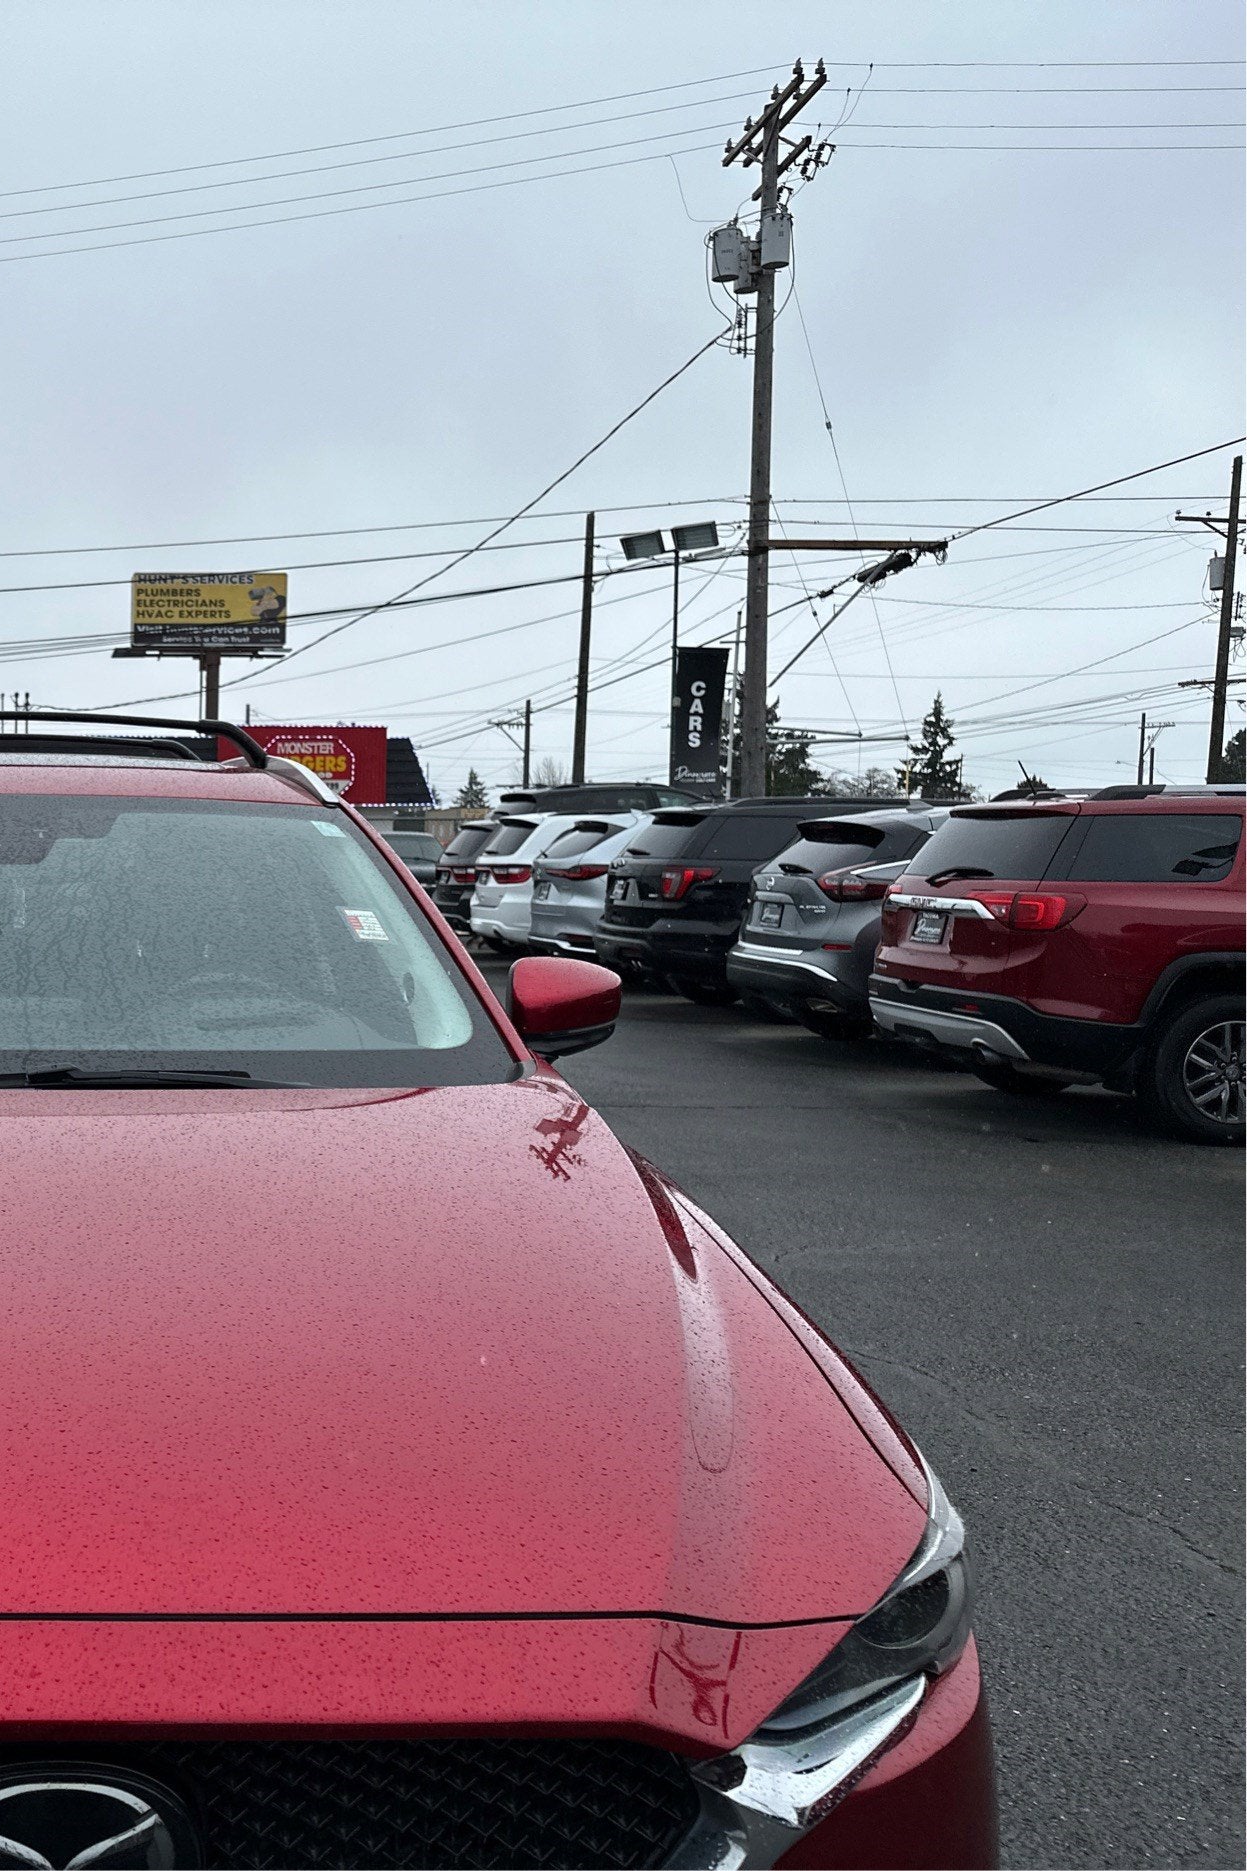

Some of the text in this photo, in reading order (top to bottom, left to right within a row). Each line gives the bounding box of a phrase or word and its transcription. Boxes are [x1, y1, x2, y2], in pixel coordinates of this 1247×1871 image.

[138, 574, 254, 584] HUNT'S SERVICES
[136, 588, 201, 597] PLUMBERS
[136, 599, 226, 608] ELECTRICIANS
[136, 610, 231, 618] HVAC EXPERTS
[136, 625, 163, 634] Visit
[230, 635, 250, 643] Trust
[687, 680, 707, 749] CARS
[277, 742, 334, 754] MONSTER
